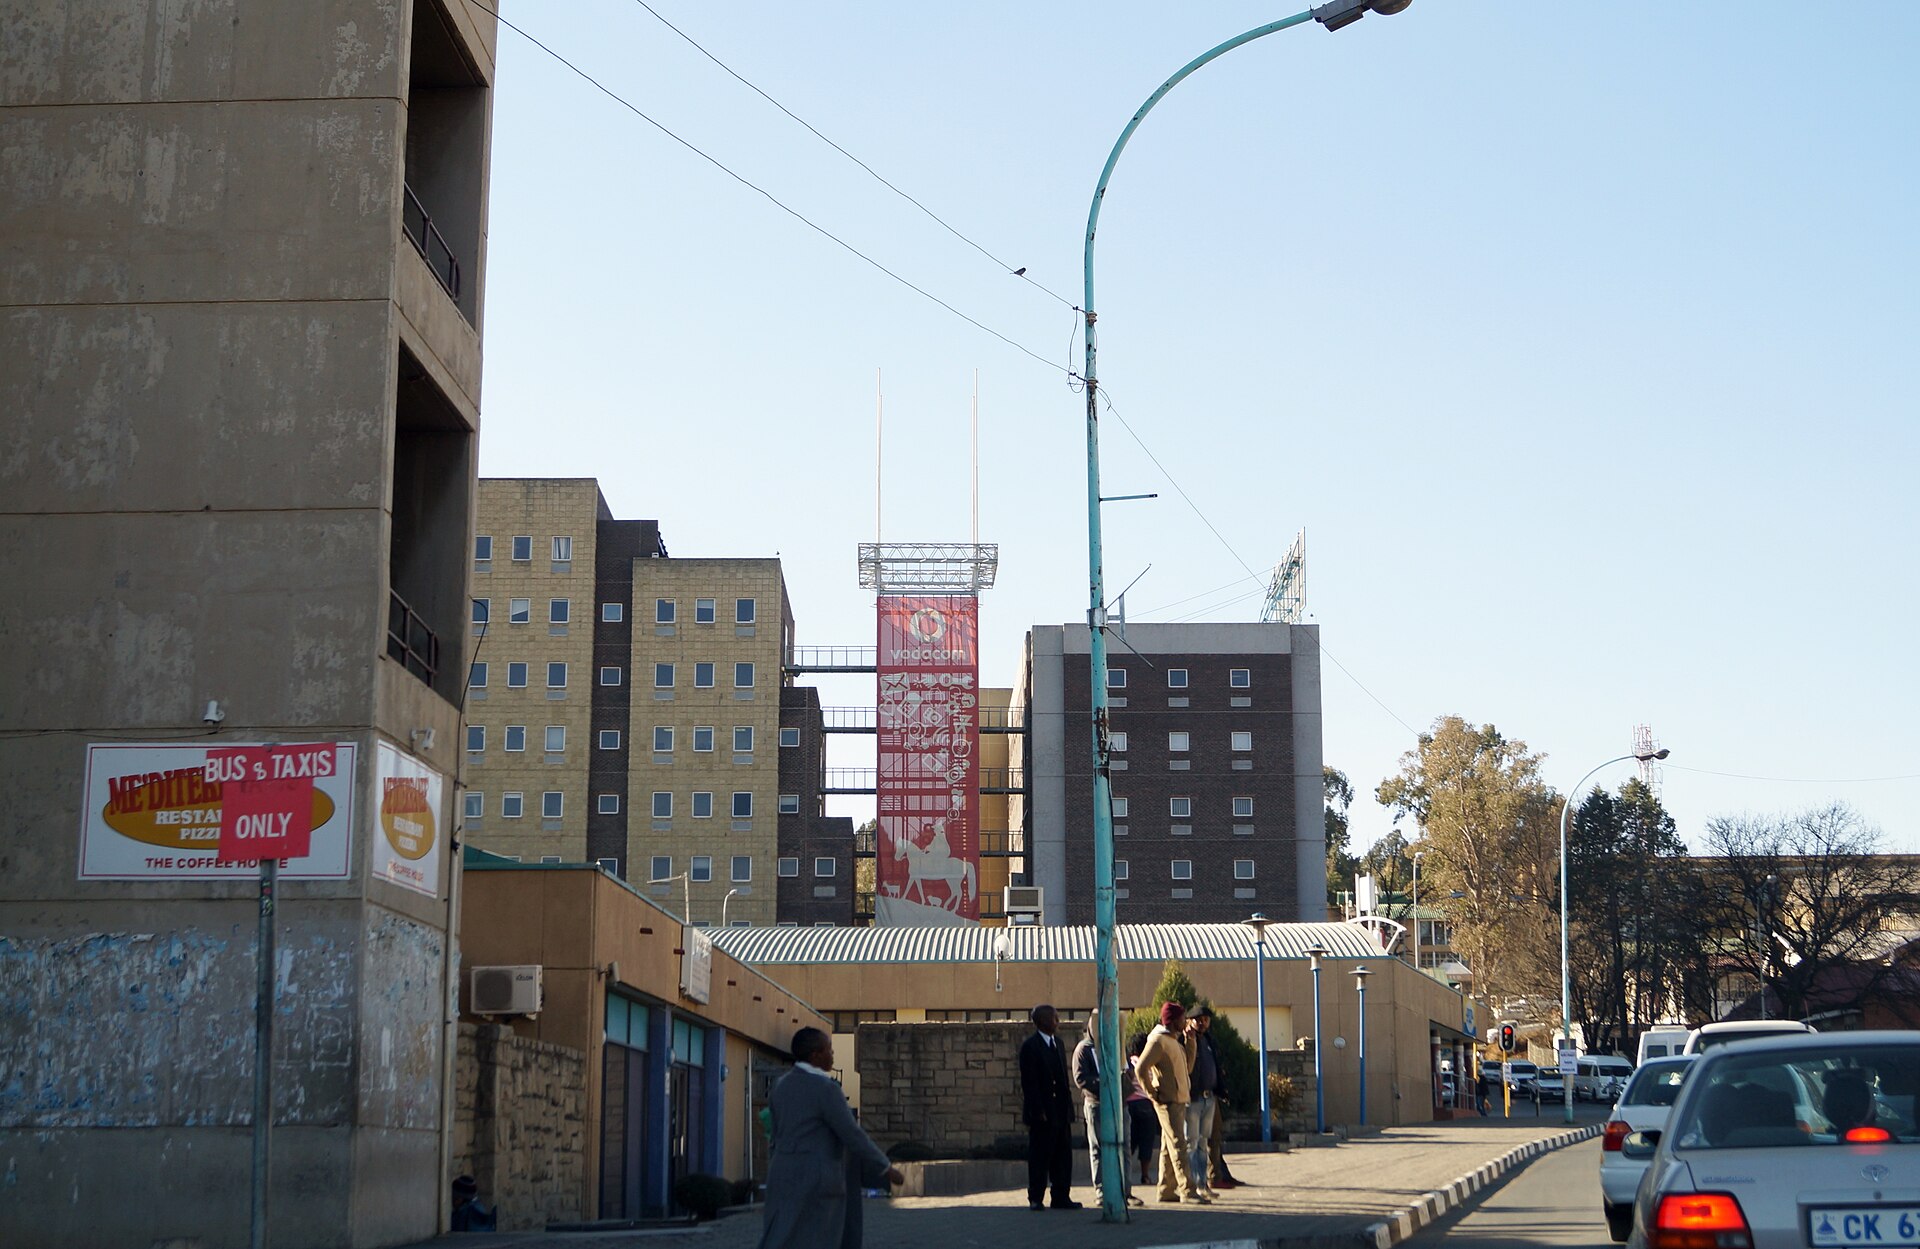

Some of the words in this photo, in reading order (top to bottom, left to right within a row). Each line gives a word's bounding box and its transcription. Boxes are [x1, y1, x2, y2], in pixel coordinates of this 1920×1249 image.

[891, 647, 966, 660] vodacom
[205, 755, 247, 782] BUS
[271, 750, 332, 778] TAXIS
[235, 812, 293, 839] ONLY
[145, 857, 173, 869] THE
[177, 857, 233, 869] COFFEE
[237, 857, 289, 869] HOE
[1843, 1214, 1882, 1240] CK
[1898, 1213, 1920, 1239] 6
